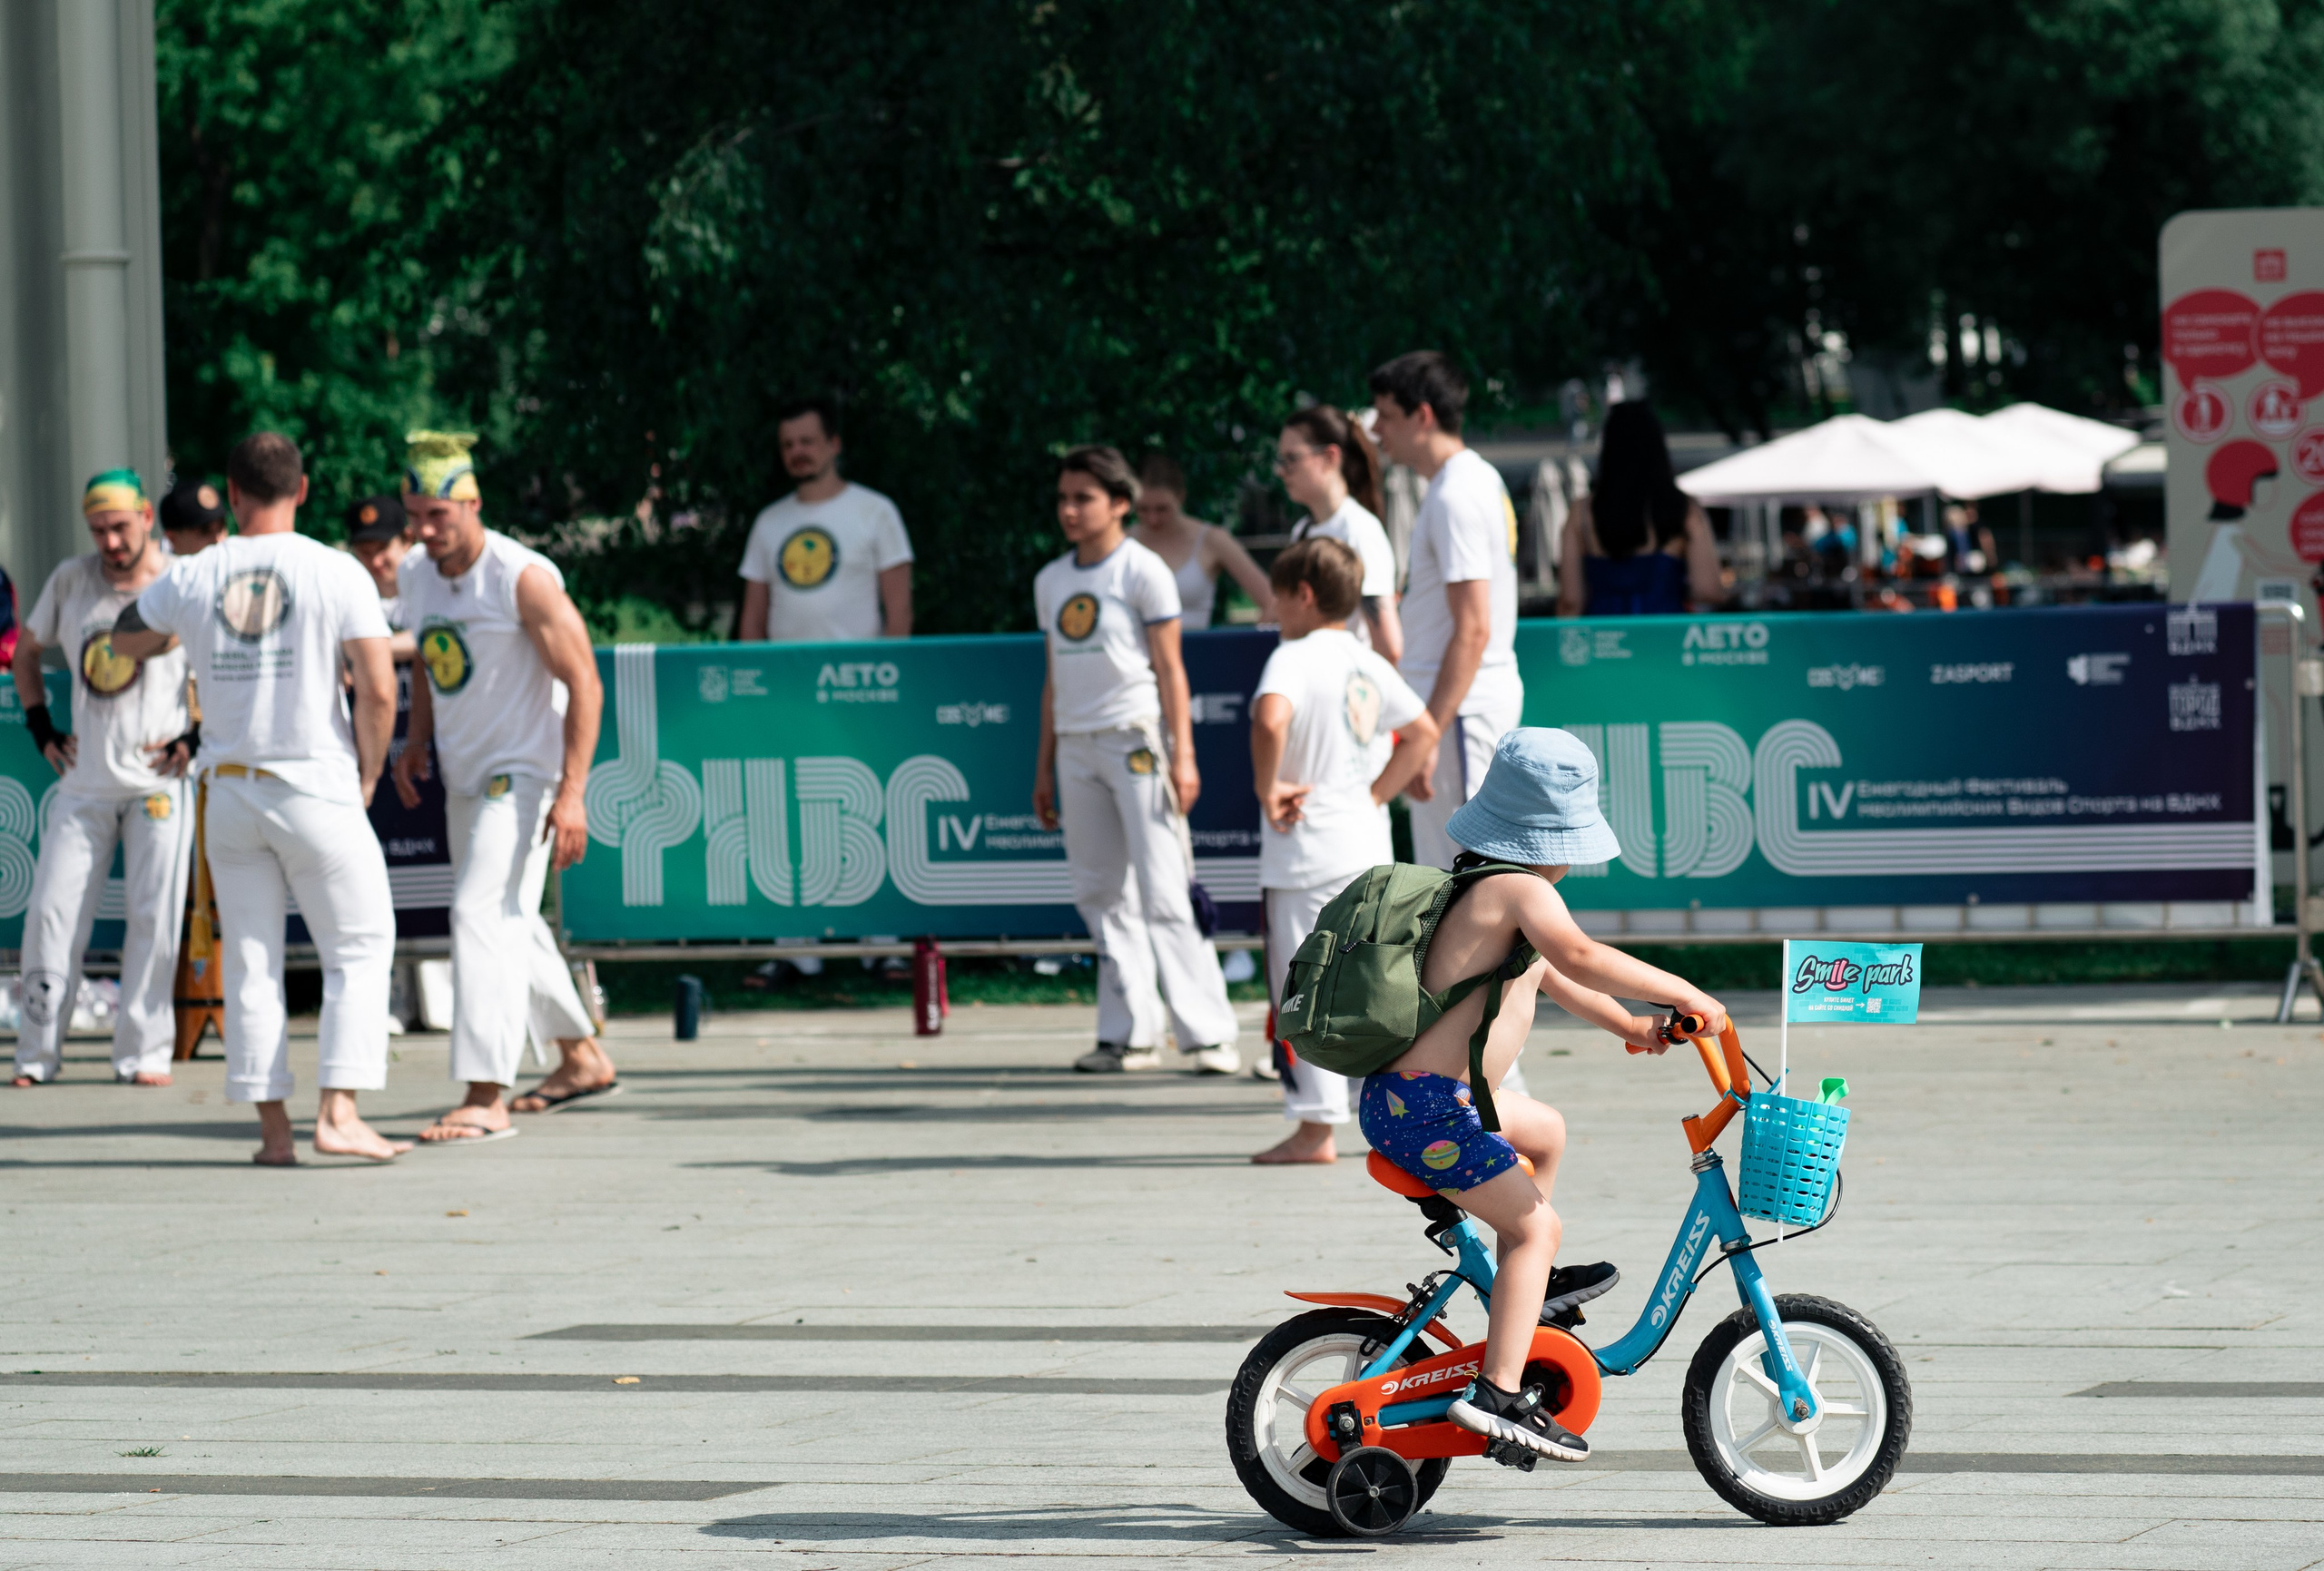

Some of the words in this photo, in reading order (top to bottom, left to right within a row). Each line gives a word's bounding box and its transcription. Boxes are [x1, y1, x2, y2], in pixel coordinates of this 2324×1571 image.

[1682, 623, 1770, 649] ЛЕТО
[817, 663, 900, 686] ЛЕТО
[1930, 663, 2014, 684] ZASPORT
[1807, 781, 1855, 820] IV
[938, 815, 983, 851] IV
[1792, 955, 1862, 994] Smile
[1863, 954, 1913, 994] park
[1660, 1209, 1710, 1310] KREISS
[1771, 1331, 1794, 1372] KREISS
[1399, 1360, 1480, 1391] KREISS
